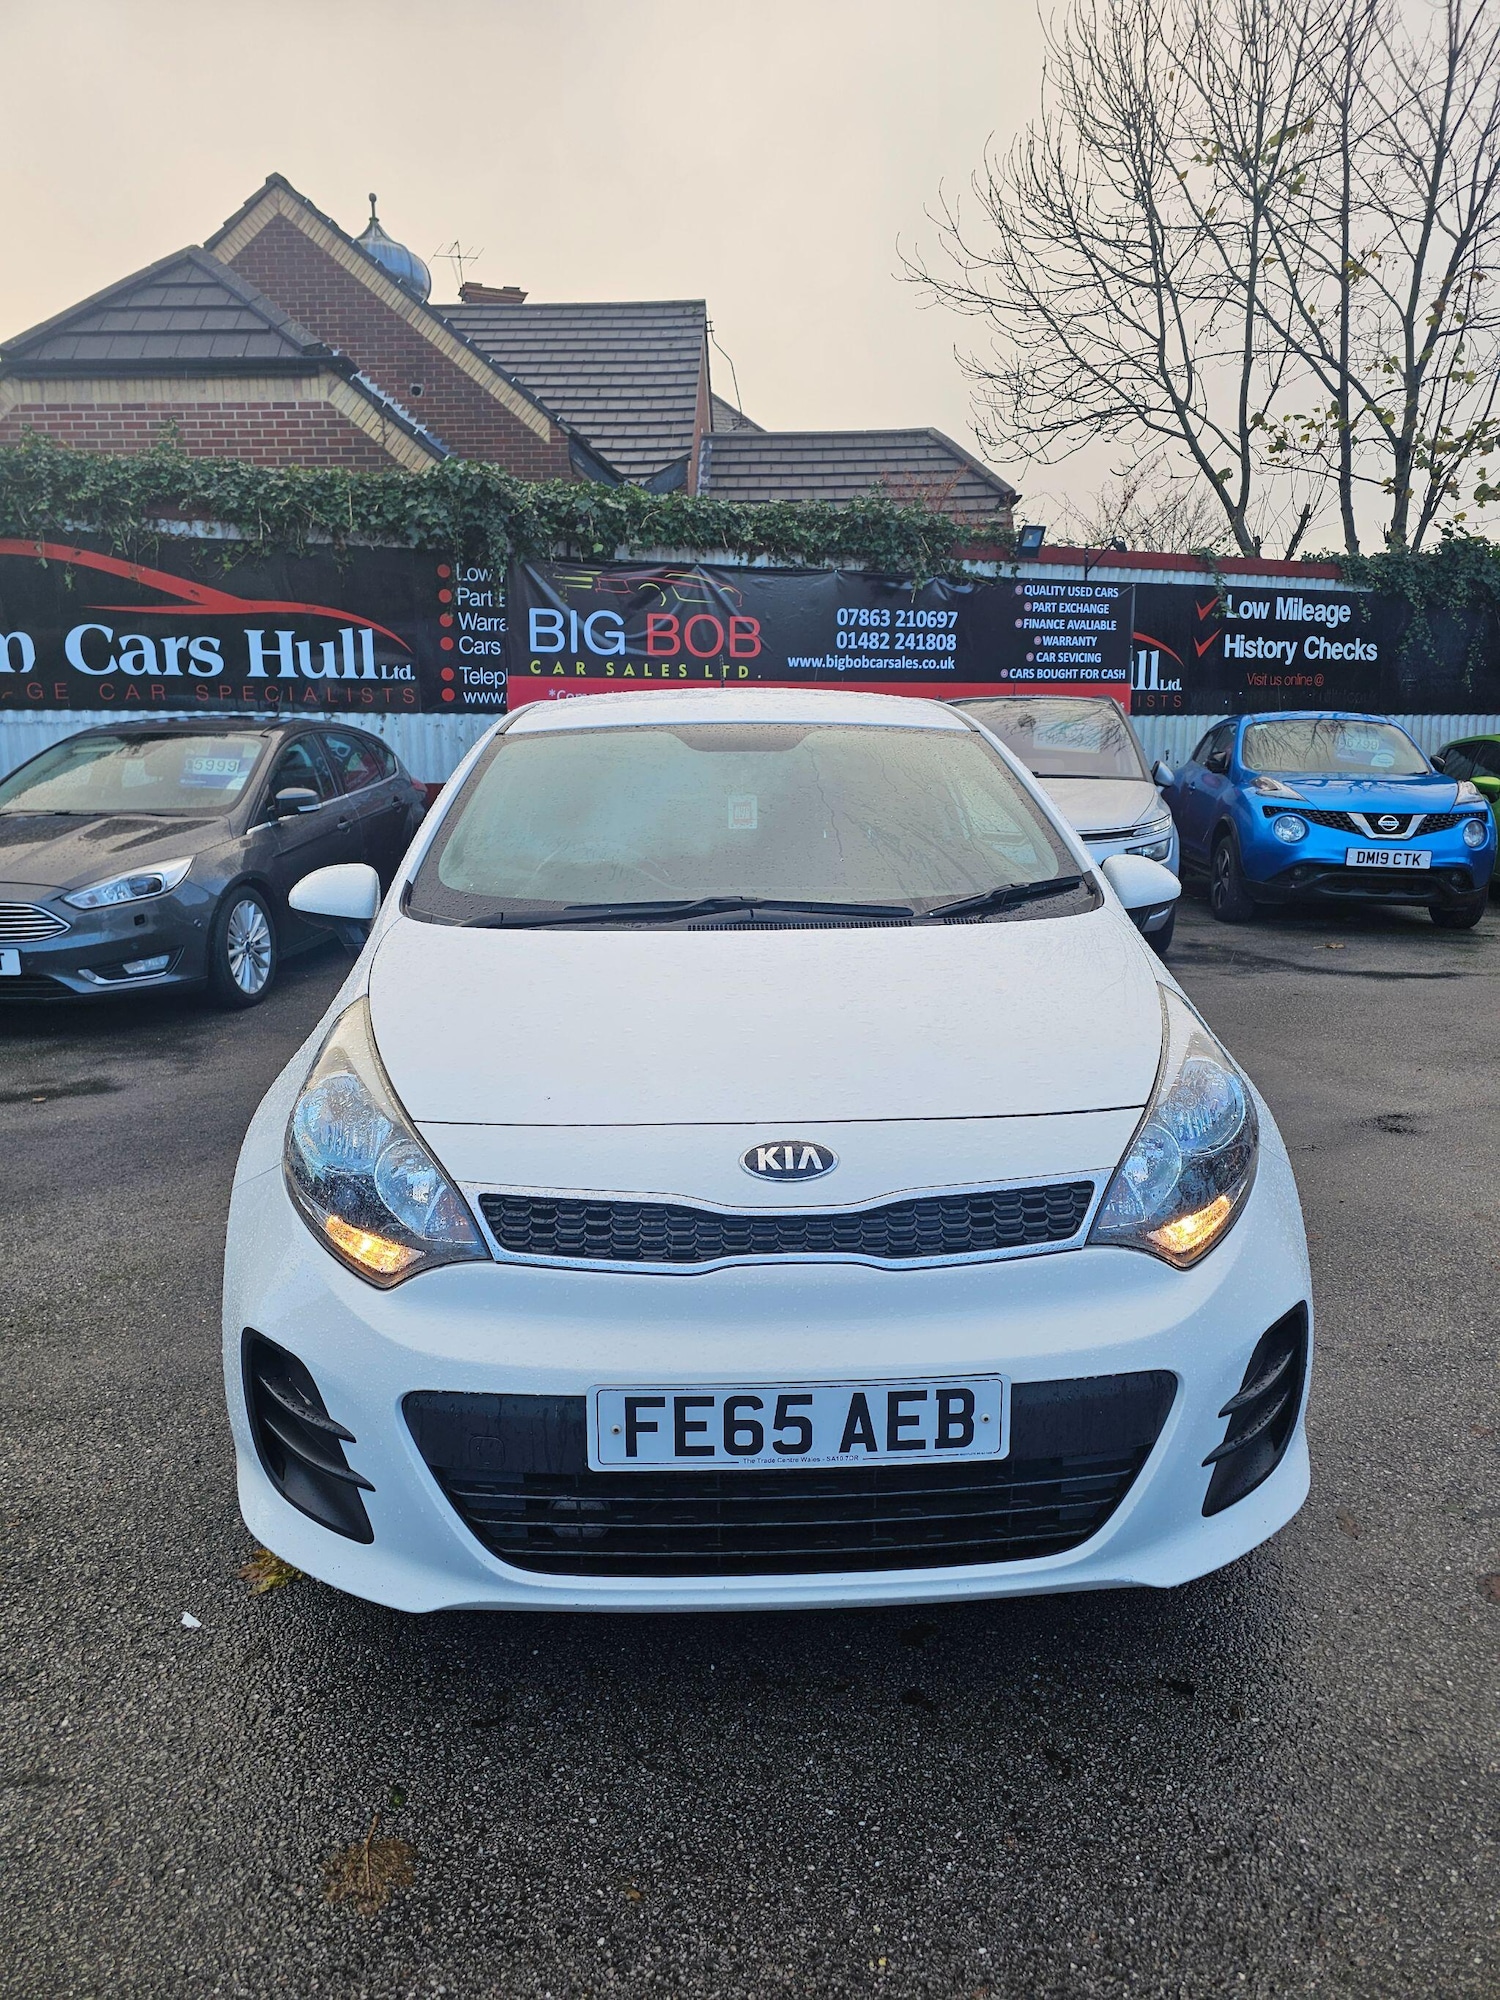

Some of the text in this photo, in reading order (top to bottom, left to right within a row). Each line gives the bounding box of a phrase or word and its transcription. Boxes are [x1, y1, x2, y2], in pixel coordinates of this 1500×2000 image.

[456, 563, 493, 582] Low
[457, 587, 493, 607] Part
[1024, 585, 1119, 598] QUALITY USED CARS
[1032, 602, 1110, 614] PART EXCHANGE
[1226, 594, 1351, 628] Low Mileage
[836, 608, 958, 628] 07863 210697
[1023, 619, 1117, 631] FINANCE AVALIABLE
[529, 607, 762, 658] BIG BOB
[836, 631, 957, 651] 01482 241808
[1042, 636, 1098, 647] WARRANTY
[64, 623, 225, 678] Cars
[243, 627, 379, 680] Hull
[380, 664, 416, 681] Ltd.
[458, 636, 501, 655] Cars
[1224, 634, 1378, 665] History Checks
[787, 654, 955, 671] www.bigbobcarsales.co.uk
[1036, 652, 1102, 663] CAR SEVICING
[459, 667, 508, 689] Telep
[530, 660, 586, 676] CAR
[606, 662, 688, 678] SALES
[1009, 668, 1126, 679] CARS BOUGHT FOR CASH
[1160, 679, 1182, 691] Ltd.
[1247, 672, 1269, 686] Visit
[1270, 674, 1282, 686] us
[1284, 673, 1313, 686] online
[99, 683, 166, 701] CAR
[196, 684, 416, 704] SPECIALISTS
[463, 692, 508, 704] www.
[1356, 851, 1422, 866] DM19 CTK
[756, 1146, 823, 1171] KIA
[624, 1387, 975, 1457] FE65 AEB
